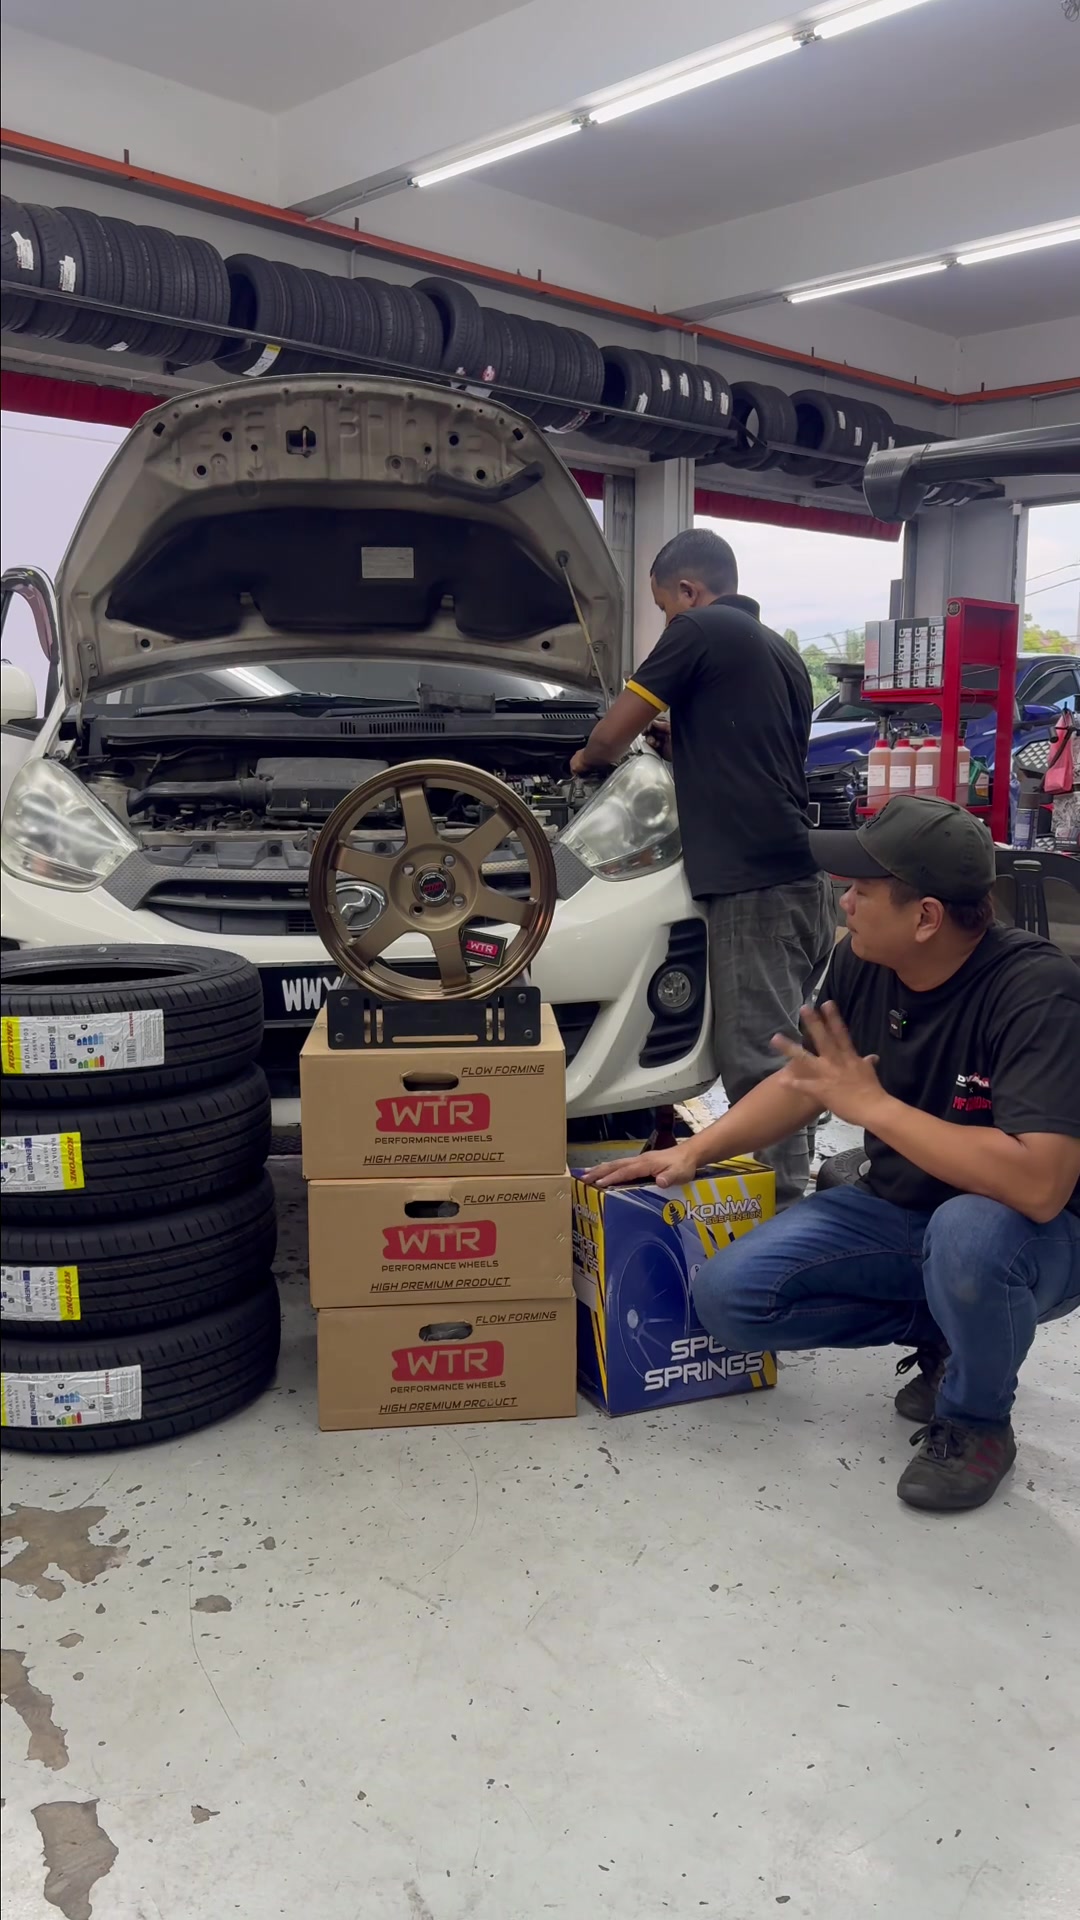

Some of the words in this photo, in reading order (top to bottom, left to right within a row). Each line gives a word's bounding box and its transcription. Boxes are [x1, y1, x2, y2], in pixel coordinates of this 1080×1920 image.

[470, 941, 493, 954] WTR
[461, 1066, 493, 1076] FLOW
[495, 1064, 545, 1074] FORMING
[391, 1100, 474, 1126] WTR
[375, 1135, 450, 1145] PERFORMANCE
[451, 1134, 493, 1144] WHEELS
[364, 1154, 391, 1164] HIGH
[394, 1153, 447, 1163] PREMIUM
[450, 1151, 504, 1162] PRODUCT
[464, 1194, 495, 1205] FLOW
[497, 1192, 546, 1202] FORMING
[706, 1211, 762, 1225] SUSPENSION
[399, 1227, 480, 1254] WTR
[381, 1262, 456, 1272] PERFORMANCE
[458, 1260, 499, 1269] WHEELS
[370, 1282, 399, 1293] HIGH
[401, 1279, 454, 1291] PREMIUM
[456, 1277, 511, 1289] PRODUCT
[476, 1315, 507, 1325] FLOW
[509, 1311, 557, 1323] FORMING
[407, 1349, 488, 1376] WTR
[644, 1352, 764, 1391] SPRINGS
[390, 1383, 464, 1394] PERFORMANCE
[466, 1381, 506, 1391] WHEELS
[380, 1403, 407, 1414] HIGH
[409, 1401, 462, 1412] PREMIUM
[464, 1398, 517, 1410] PRODUCT
